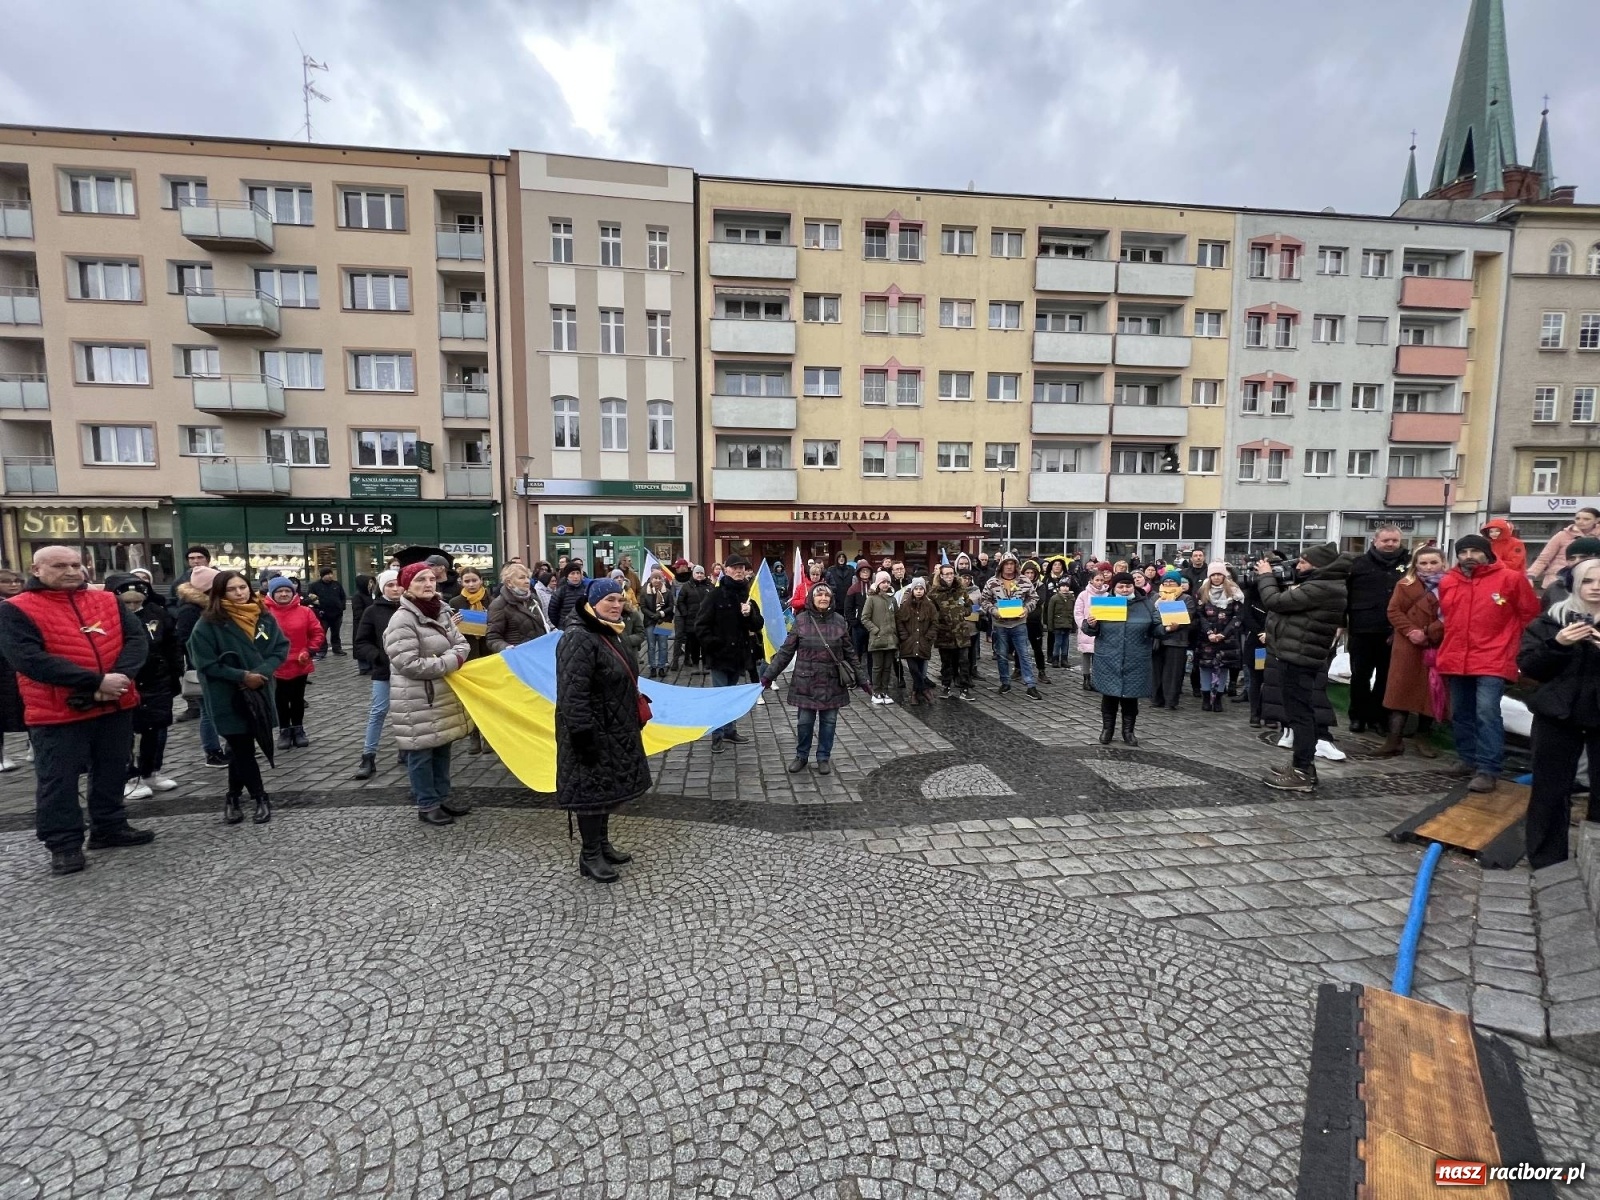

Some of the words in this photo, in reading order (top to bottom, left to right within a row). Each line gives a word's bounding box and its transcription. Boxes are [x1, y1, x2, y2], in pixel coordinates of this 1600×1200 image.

[1561, 498, 1576, 506] TEB
[23, 509, 138, 533] STELLA
[286, 513, 393, 526] JUBILER
[803, 511, 890, 521] RESTAURACJA
[1143, 518, 1176, 532] empik
[442, 544, 488, 553] CASIO
